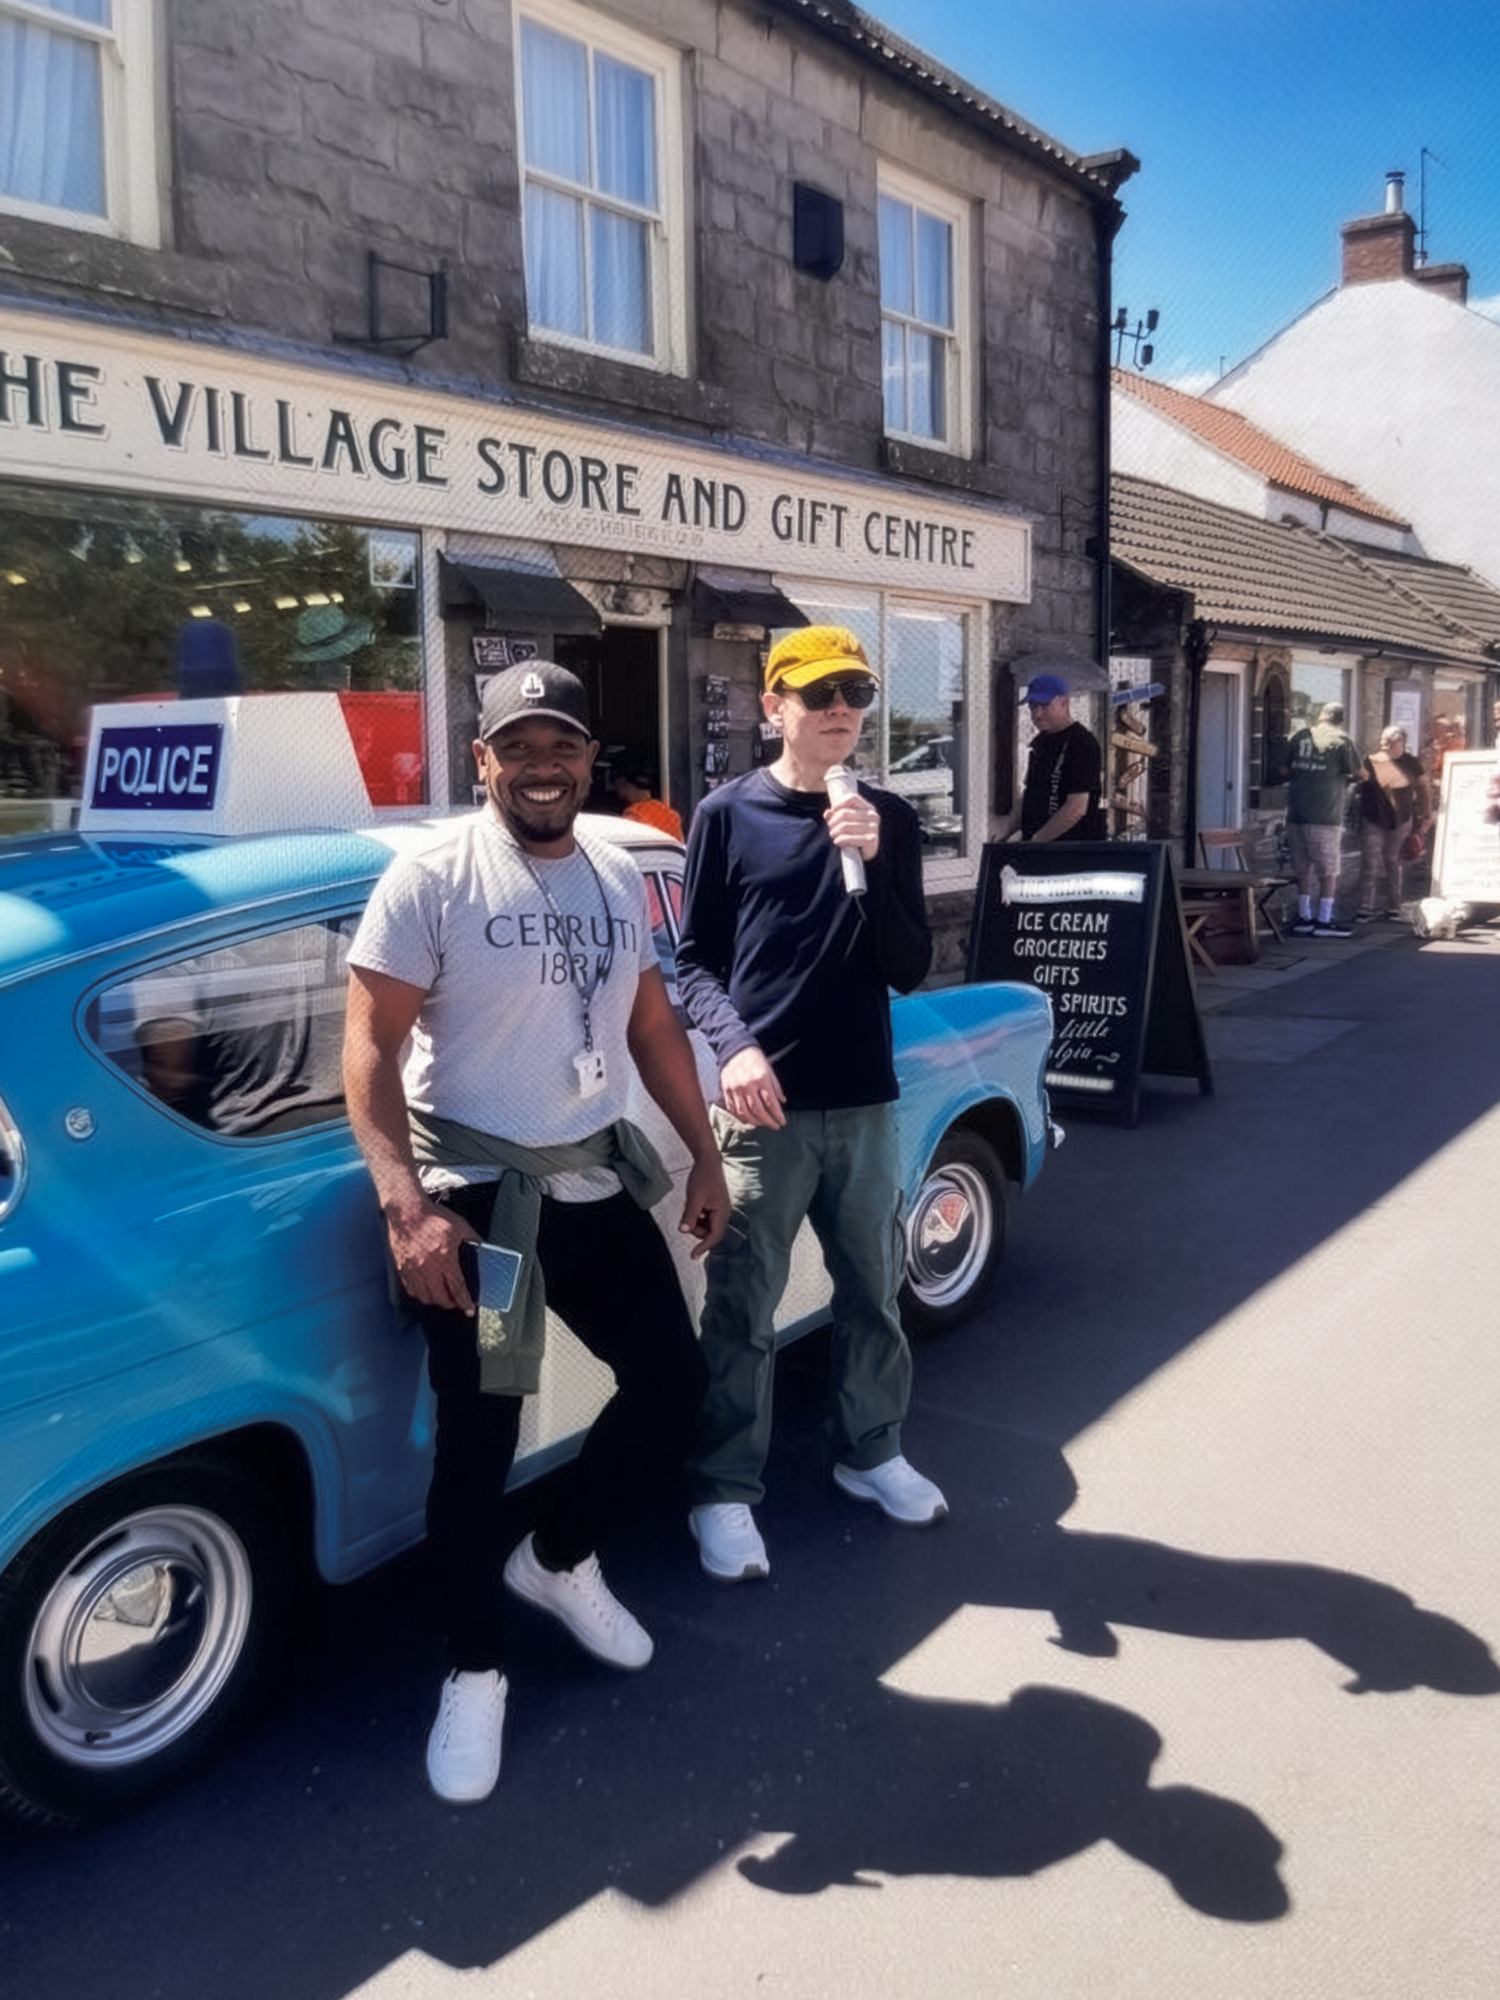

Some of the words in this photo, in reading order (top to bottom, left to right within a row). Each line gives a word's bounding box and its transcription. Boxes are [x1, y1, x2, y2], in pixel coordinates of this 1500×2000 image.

[144, 376, 450, 487] VILLAGE
[477, 438, 641, 516] STORE
[661, 473, 746, 532] AND
[771, 494, 848, 548] GIFT
[864, 511, 975, 568] CENTRE
[100, 745, 213, 796] POLICE
[485, 913, 637, 952] CERRUTI
[1017, 911, 1045, 931] ICE
[1050, 912, 1109, 933] CREAM
[1013, 938, 1108, 961] GROCERIES
[1033, 965, 1080, 986] GIFTS
[1059, 993, 1127, 1016] SPIRITS
